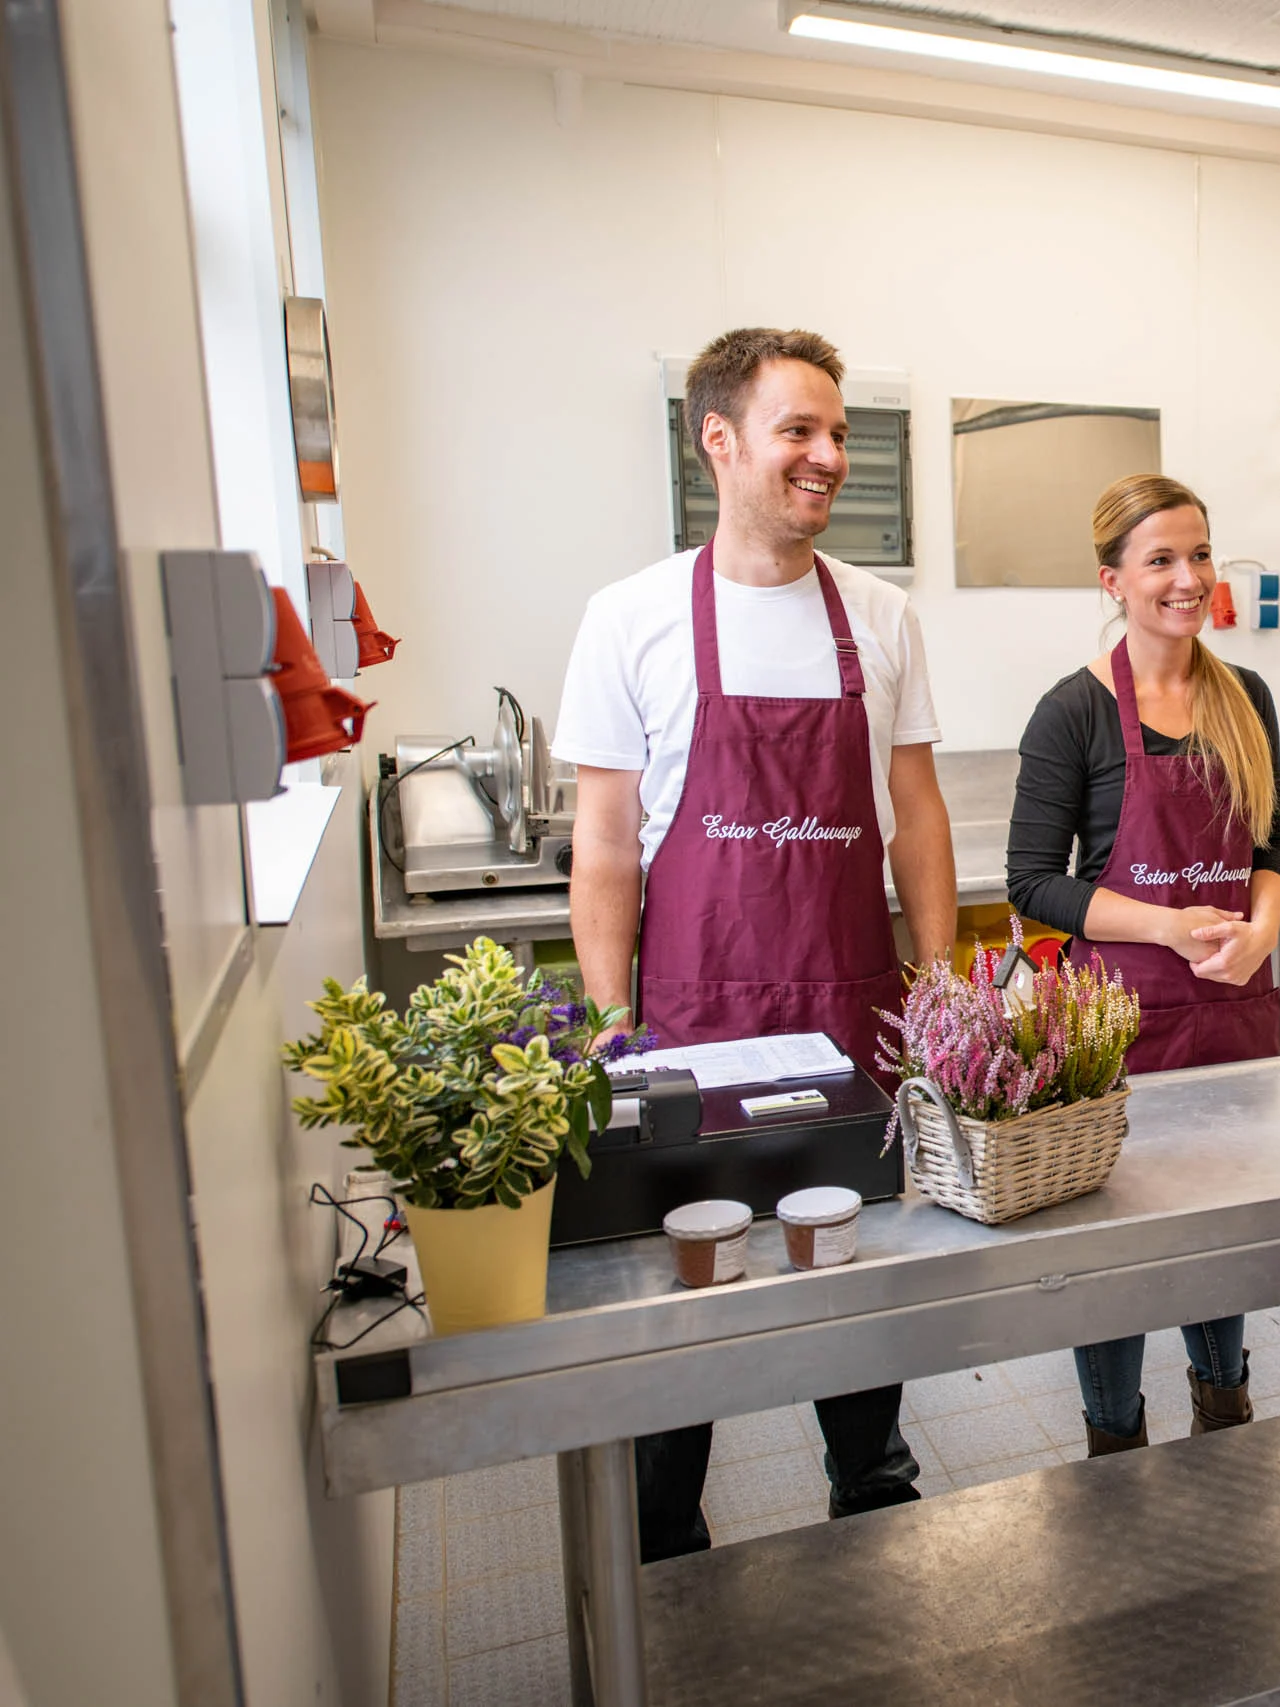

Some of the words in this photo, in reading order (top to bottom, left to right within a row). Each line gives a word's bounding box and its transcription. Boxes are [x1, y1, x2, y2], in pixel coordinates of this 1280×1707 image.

[702, 814, 758, 839] Estor
[762, 816, 863, 848] Galloways
[1130, 863, 1179, 885] Estor
[1181, 860, 1252, 891] Galloway
